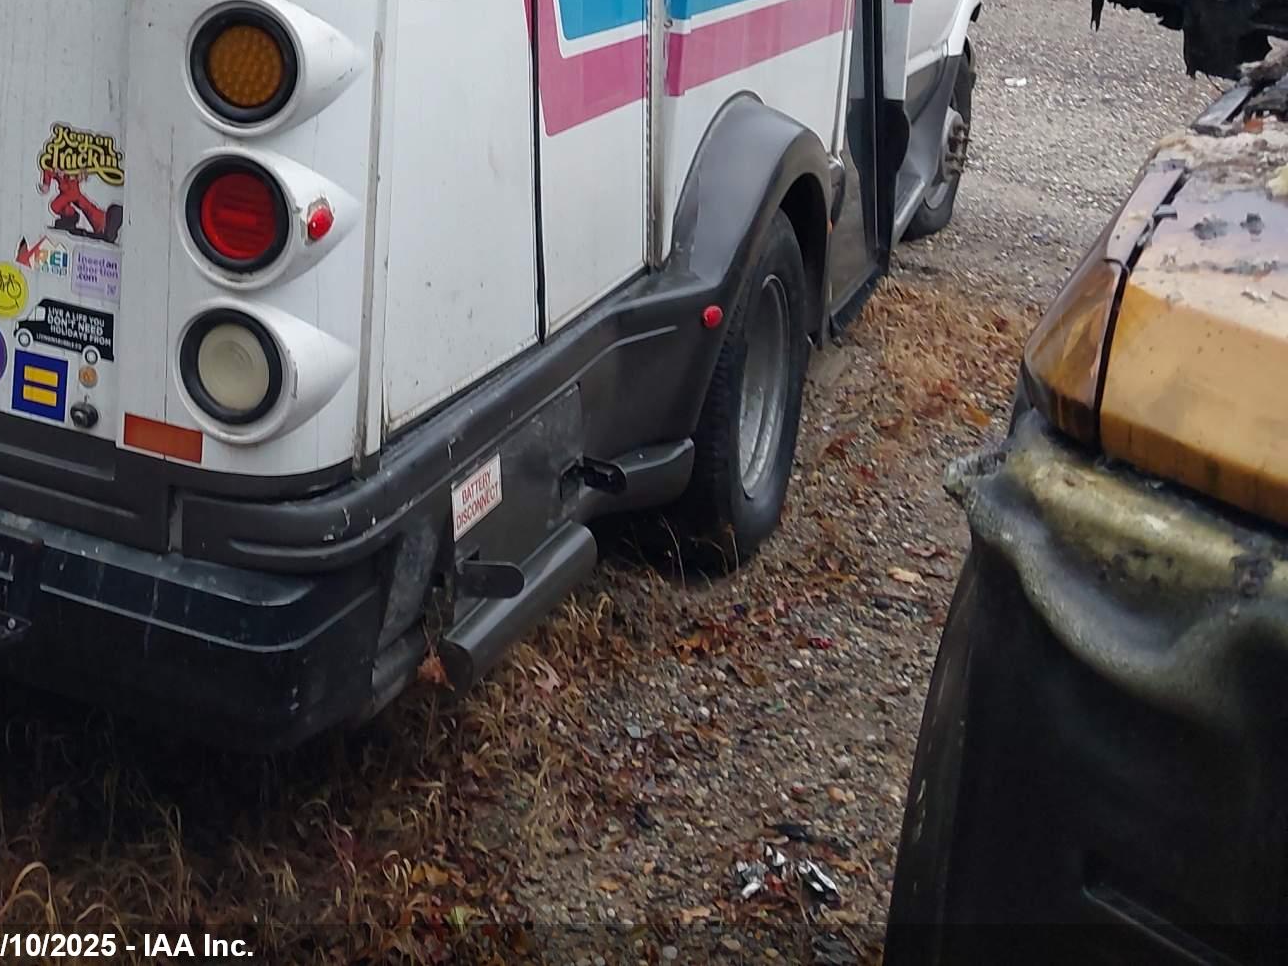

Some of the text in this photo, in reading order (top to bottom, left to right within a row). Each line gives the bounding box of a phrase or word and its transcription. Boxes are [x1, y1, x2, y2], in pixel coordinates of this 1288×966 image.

[52, 122, 94, 152] Keep
[34, 249, 68, 268] REI
[48, 306, 64, 318] LIVE
[72, 311, 88, 324] LIFE
[89, 315, 105, 327] YOU
[78, 320, 104, 336] NEED
[50, 323, 88, 342] HOLIDAYS
[90, 334, 111, 347] FROM
[462, 468, 492, 504] BATTERY
[456, 481, 499, 530] DISCONNECT
